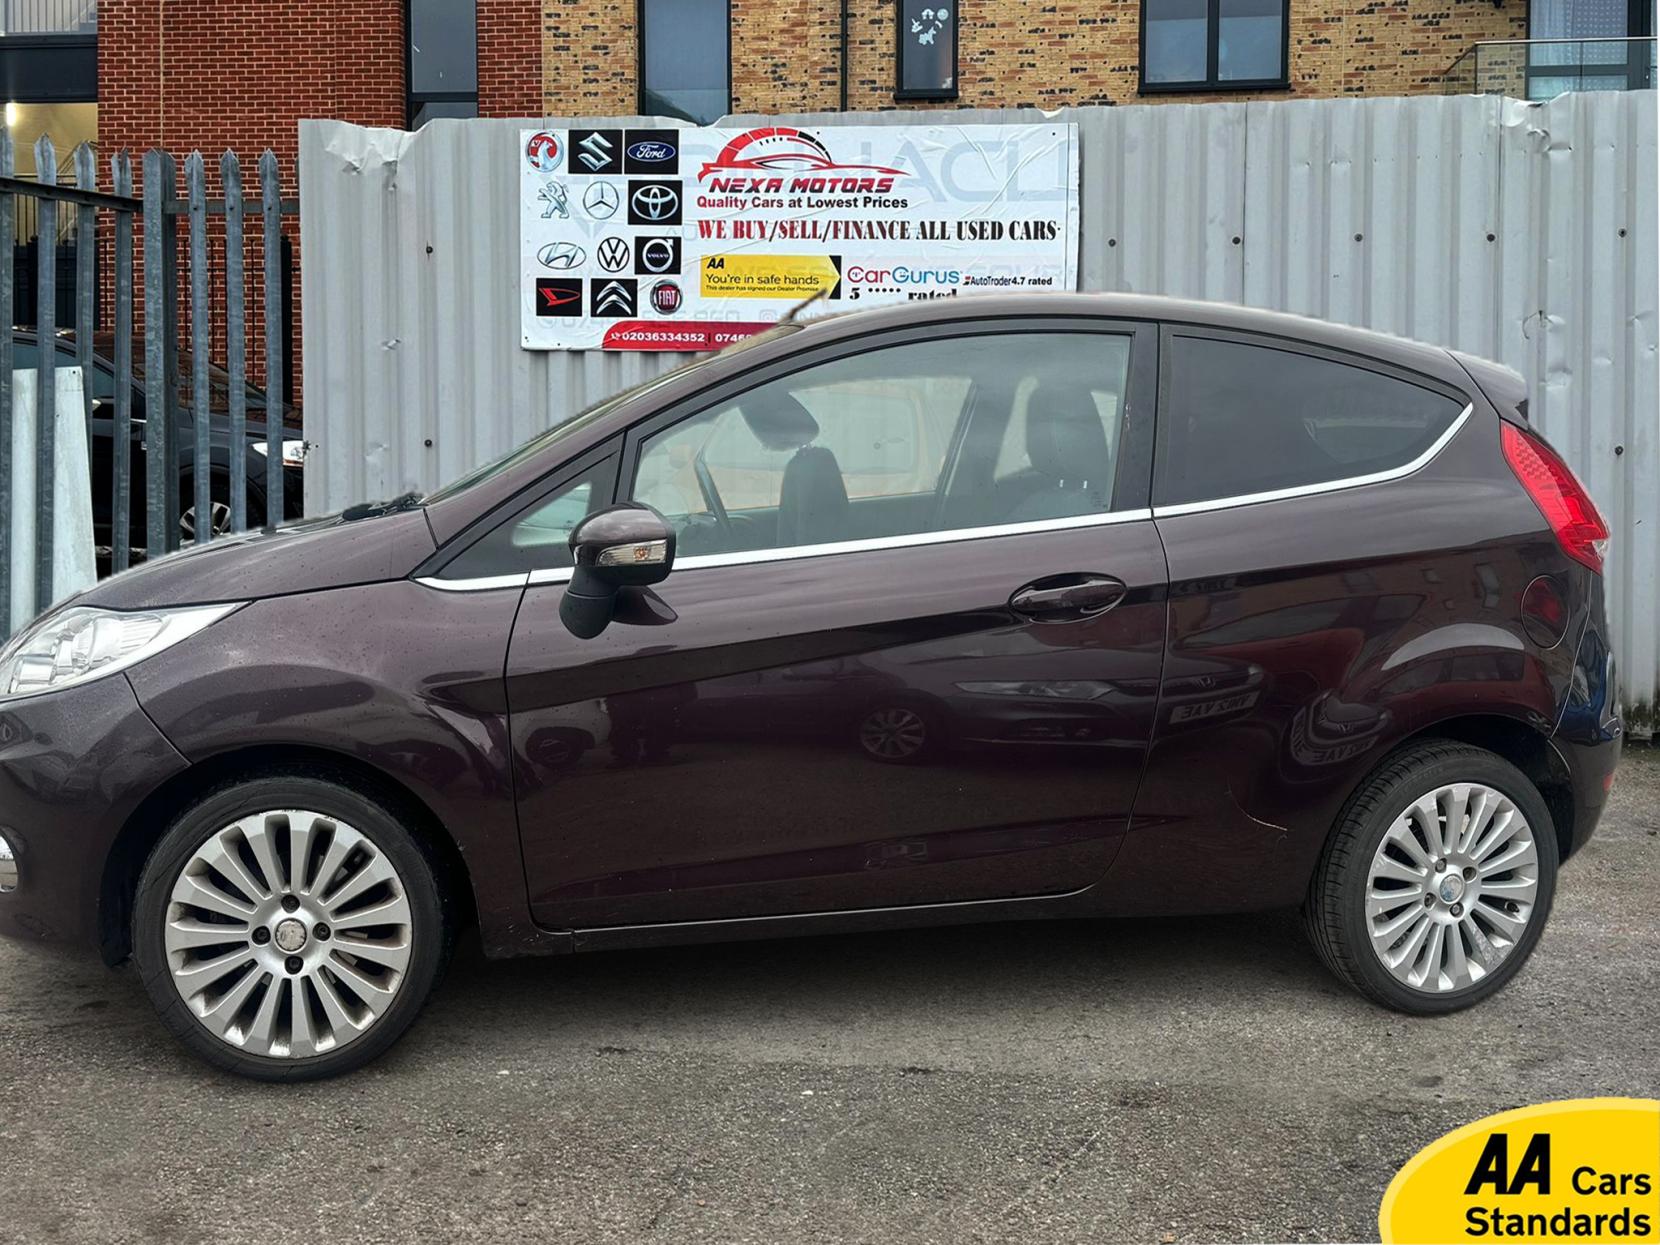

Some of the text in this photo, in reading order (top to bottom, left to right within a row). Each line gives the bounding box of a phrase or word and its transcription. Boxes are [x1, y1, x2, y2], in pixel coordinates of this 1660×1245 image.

[636, 144, 667, 159] Ford
[709, 177, 895, 193] NEXA MOTORS
[697, 196, 908, 210] Quality Cars at Lowest Prices
[697, 220, 726, 239] WE
[916, 221, 950, 240] ALL
[957, 220, 1003, 241] USED
[1008, 220, 1057, 241] CARS
[706, 257, 725, 269] AA
[706, 273, 819, 285] You're in safe hands
[847, 266, 960, 284] CarGurus
[1028, 277, 1053, 285] rated
[658, 289, 676, 306] FIAT
[849, 287, 860, 300] 5
[622, 332, 705, 342] 02036334352
